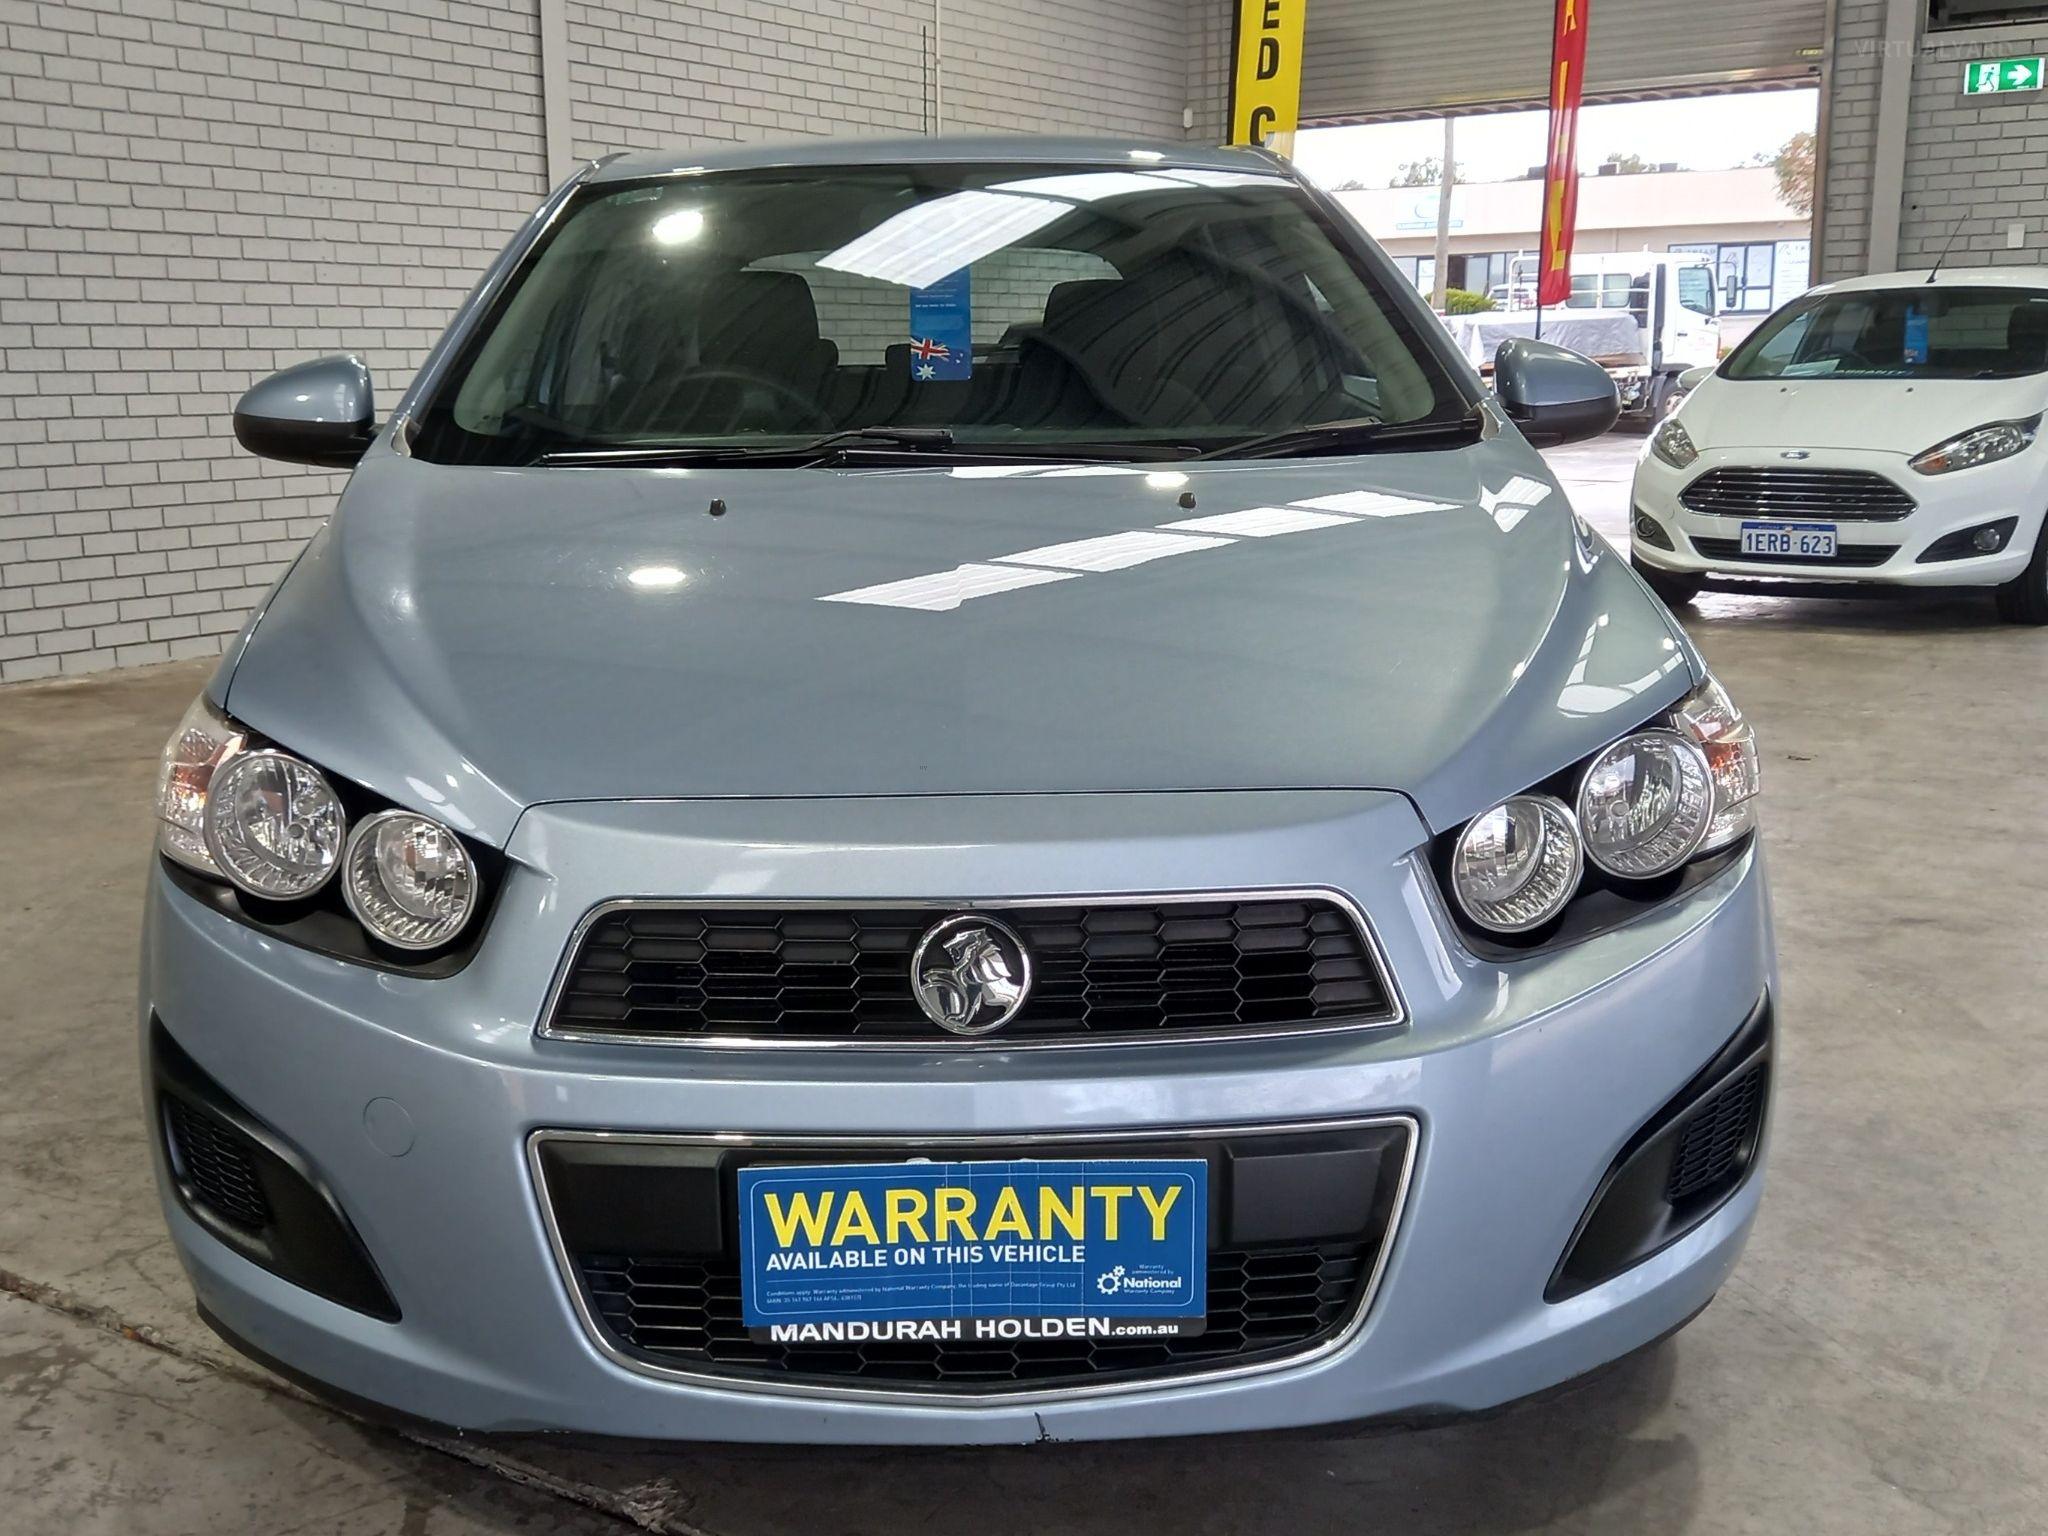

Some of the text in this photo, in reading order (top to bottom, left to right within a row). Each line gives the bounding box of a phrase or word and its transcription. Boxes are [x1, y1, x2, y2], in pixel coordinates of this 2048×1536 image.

[763, 1185, 1183, 1248] WARRANTY
[766, 1245, 1086, 1271] AVAILABLE ON THIS VEHICLE
[1123, 1276, 1182, 1289] National
[770, 1319, 961, 1342] MANDURAH
